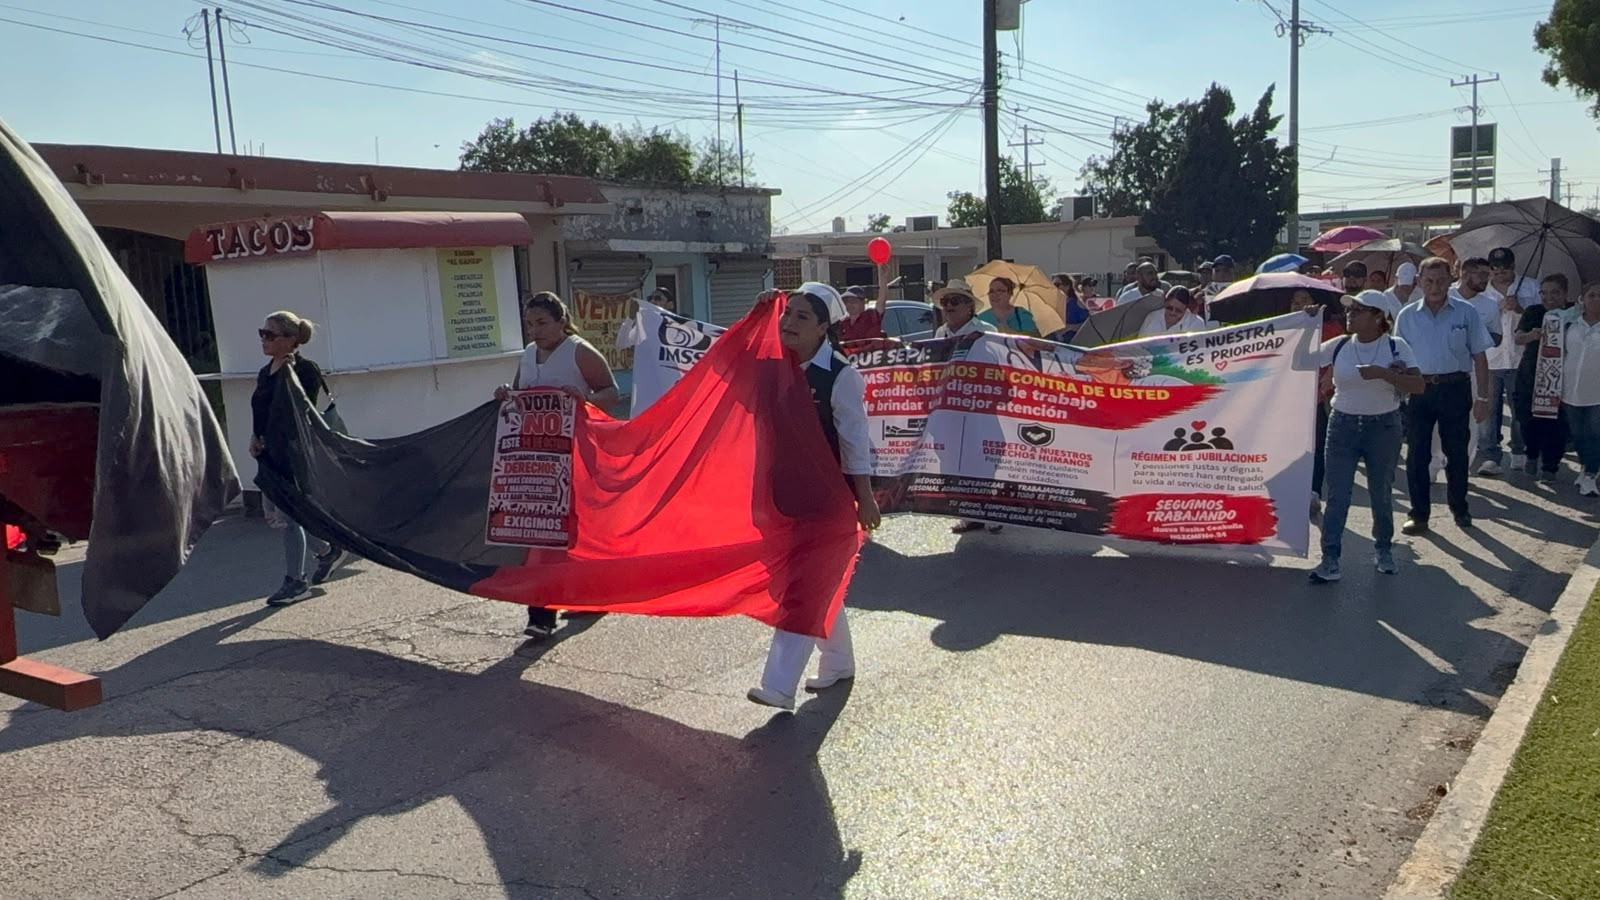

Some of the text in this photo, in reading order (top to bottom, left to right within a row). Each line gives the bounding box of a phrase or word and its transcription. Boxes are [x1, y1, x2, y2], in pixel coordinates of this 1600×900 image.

[206, 217, 314, 260] TACOS
[1178, 324, 1275, 354] ES NUESTRA
[848, 350, 882, 368] QUE
[1186, 337, 1285, 365] ES PRIORIDAD
[864, 371, 891, 384] MSS
[893, 371, 914, 382] NO
[983, 368, 1005, 381] EN
[1009, 371, 1078, 394] CONTRA
[1082, 385, 1105, 397] DE
[1109, 388, 1170, 400] USTED
[523, 395, 561, 411] VOTA
[872, 380, 1098, 409] condicione dignas de trabajo
[876, 401, 924, 412] brindar
[946, 396, 993, 412] mejor
[996, 400, 1068, 419] atención
[523, 412, 562, 436] NO
[501, 437, 520, 450] ESTE
[982, 440, 1027, 451] RESPETO
[1040, 447, 1093, 461] NUESTROS
[982, 448, 1091, 468] DERECHOS HUMANOS
[1131, 451, 1268, 463] RÉGIMEN DE JUBILACIONES
[504, 462, 557, 475] DERECHOS
[1014, 459, 1047, 470] quienes
[1049, 464, 1089, 475] cuidamos
[1029, 469, 1079, 480] merecemos
[1192, 464, 1220, 472] justas
[1222, 466, 1228, 474] y
[497, 477, 507, 485] NO
[1145, 478, 1165, 486] vida
[1177, 480, 1212, 489] servicio
[1213, 483, 1225, 491] de
[1227, 483, 1236, 491] la
[1157, 471, 1194, 479] quienes
[1196, 472, 1214, 480] han
[1216, 474, 1264, 484] entregado
[914, 477, 946, 485] MÉDICOS
[1017, 484, 1076, 497] TRABAJADORES
[941, 487, 998, 496] ADMINISTRATIVO
[1048, 494, 1088, 505] PERSONAL
[503, 516, 561, 530] EXIGIMOS
[1146, 510, 1237, 522] TRABAJANDO
